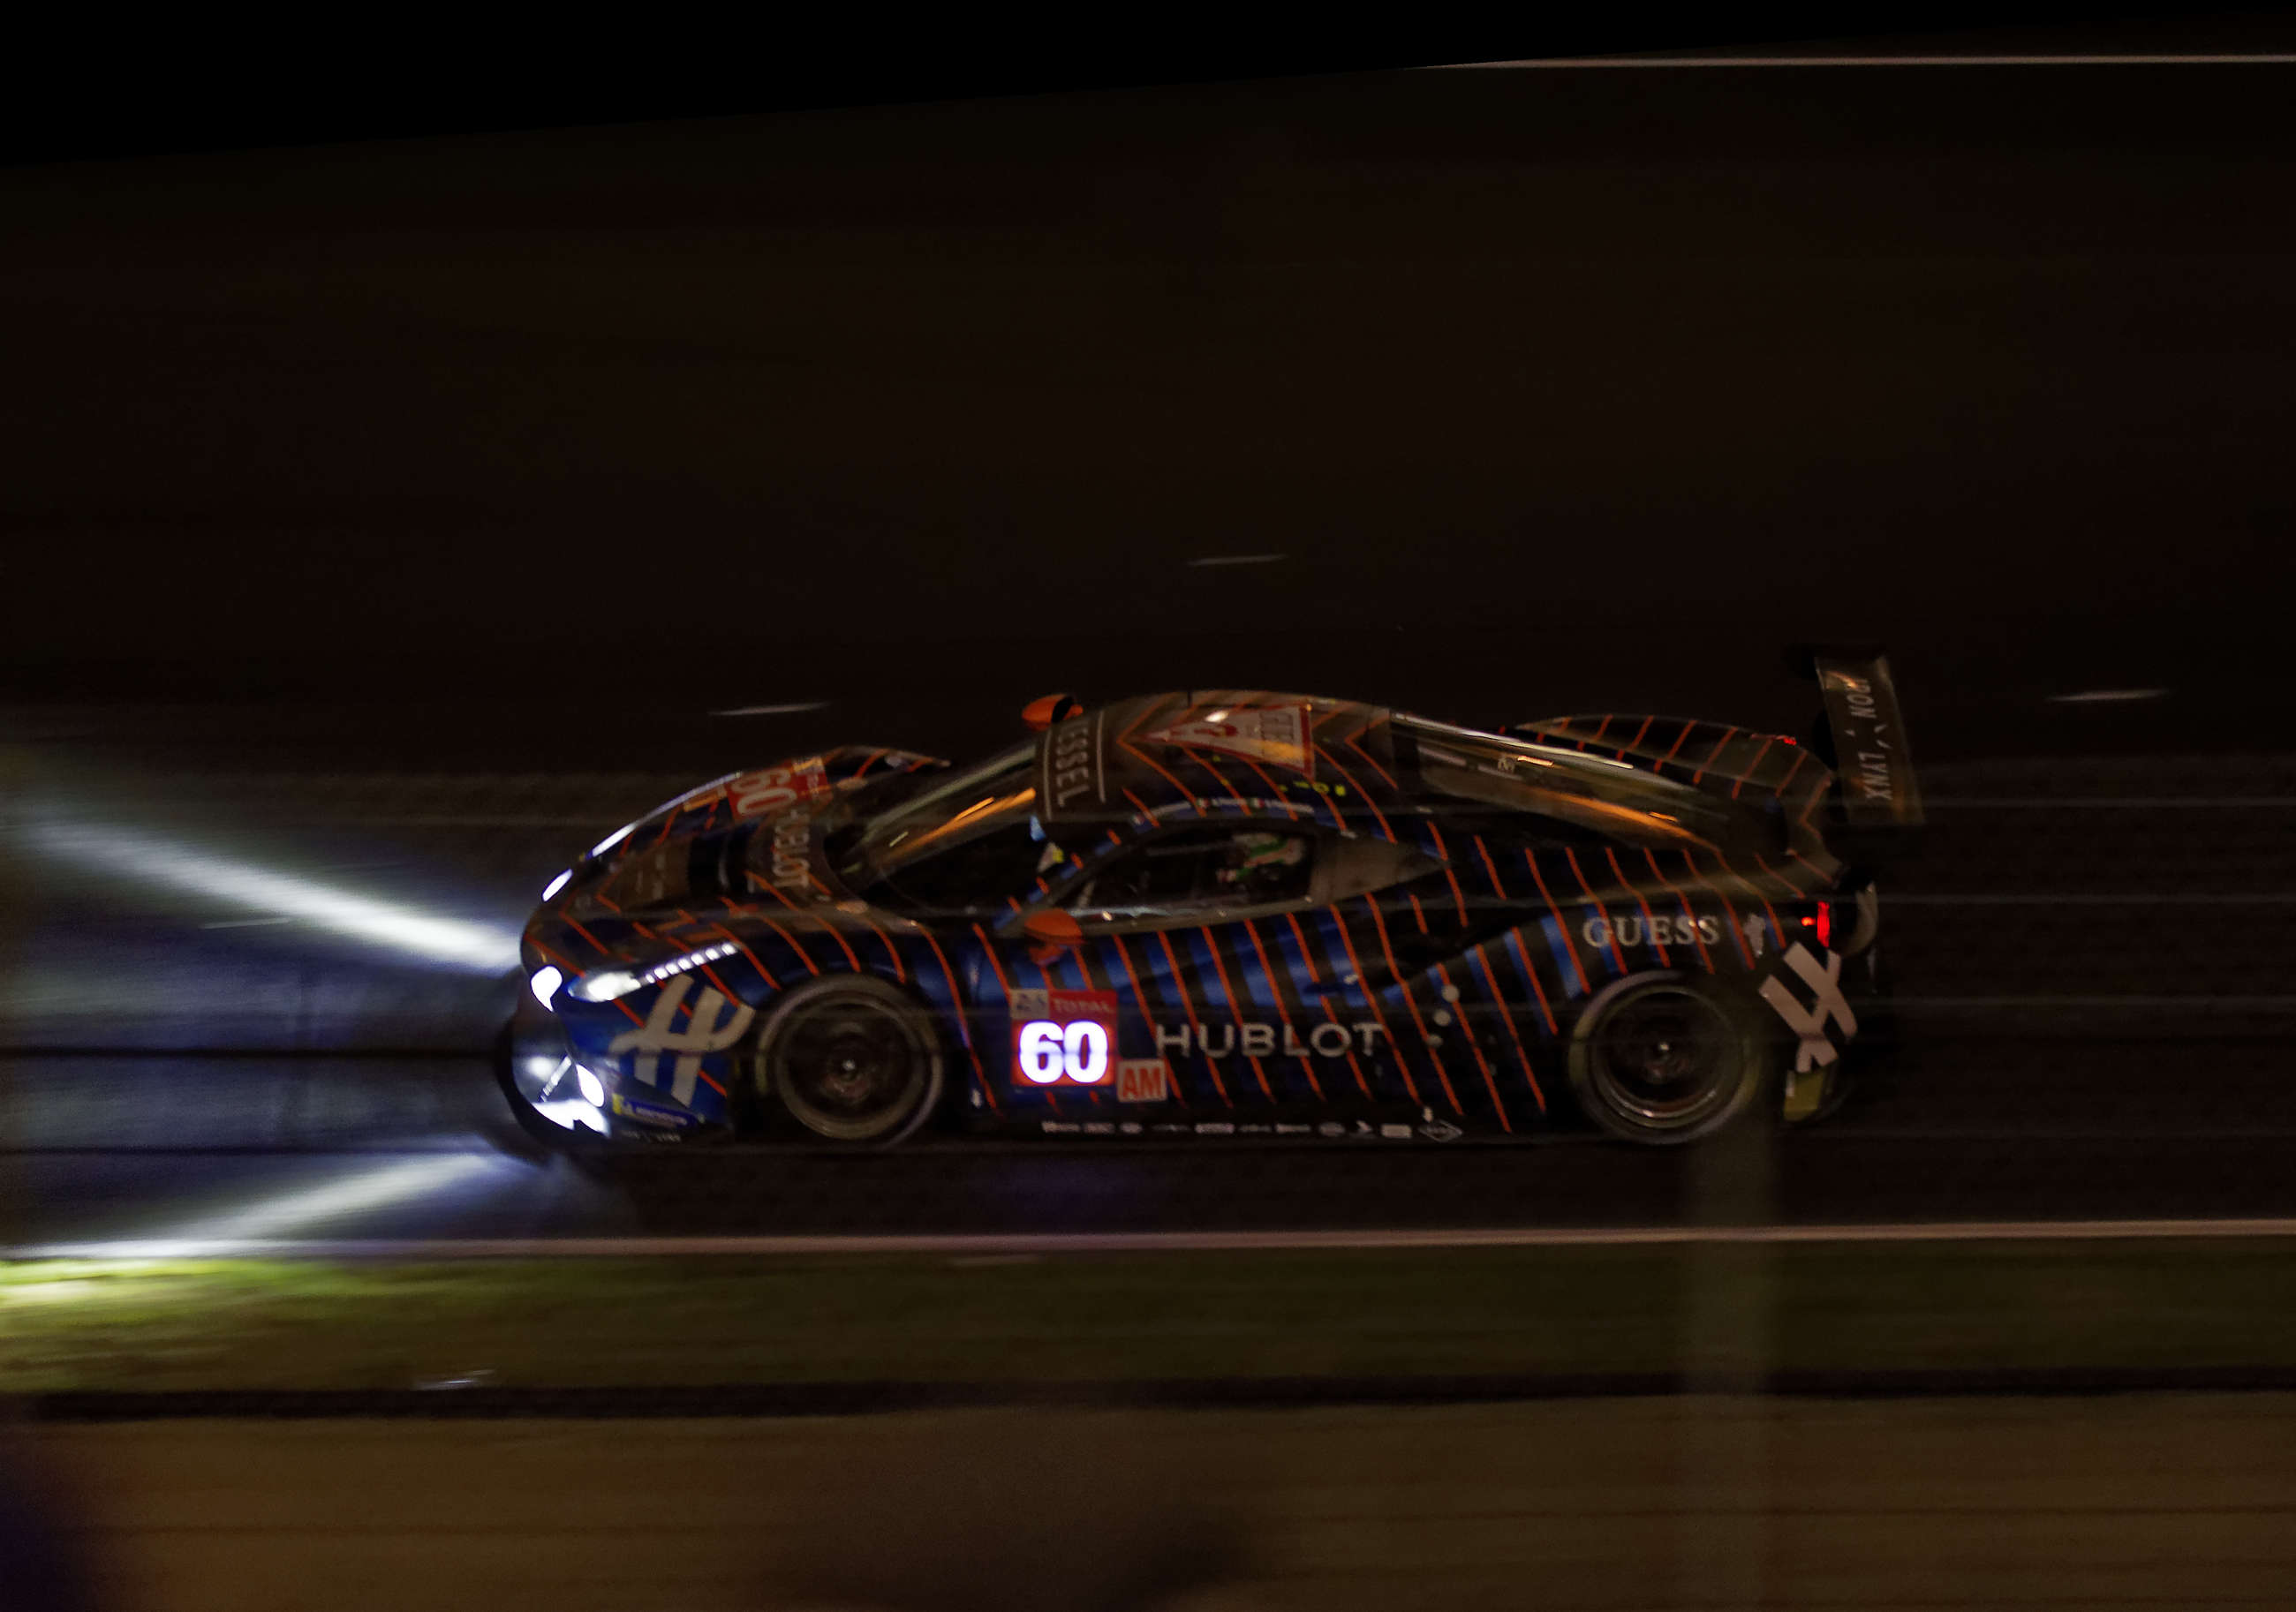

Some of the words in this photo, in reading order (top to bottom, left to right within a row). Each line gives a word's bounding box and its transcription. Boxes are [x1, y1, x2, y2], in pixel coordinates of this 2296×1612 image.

[730, 767, 798, 817] 60
[1857, 750, 1893, 800] LYNX
[1582, 915, 1720, 948] GUESS
[1018, 1019, 1110, 1085] 60
[1155, 1021, 1385, 1059] HUBLOT
[1122, 1067, 1161, 1098] AM
